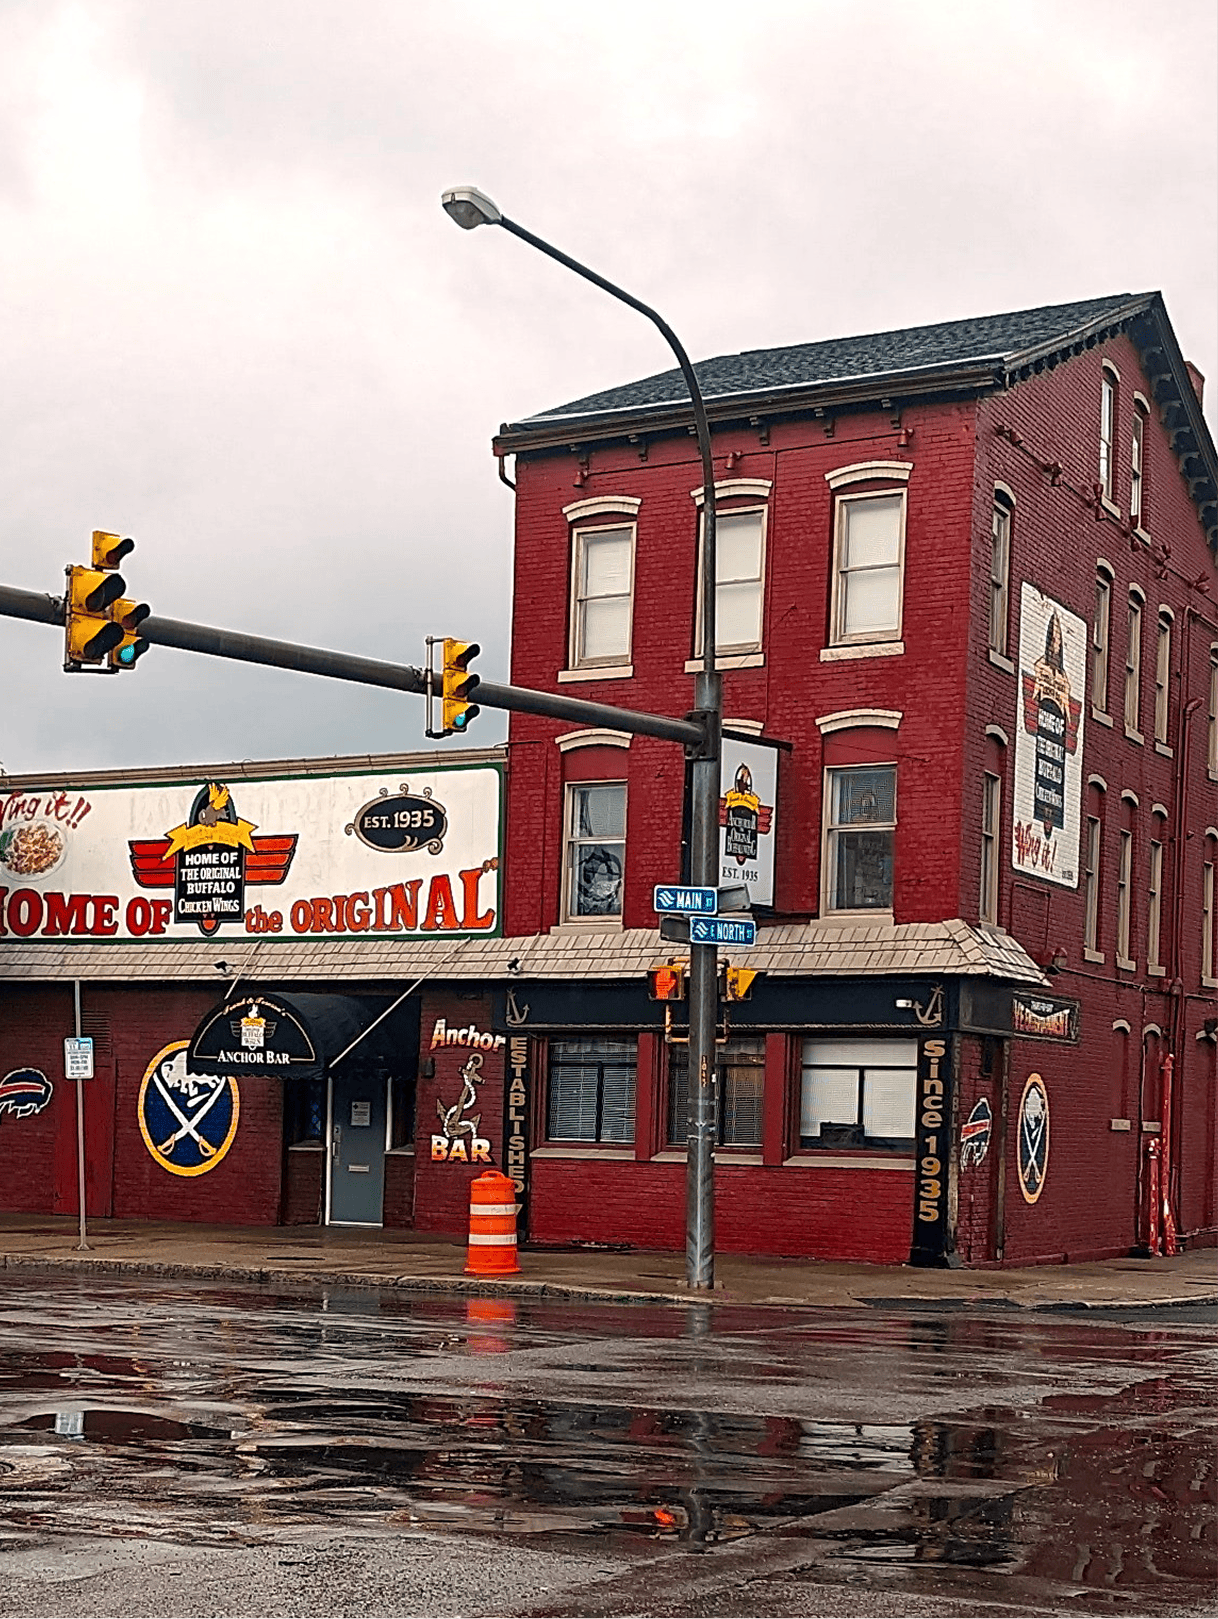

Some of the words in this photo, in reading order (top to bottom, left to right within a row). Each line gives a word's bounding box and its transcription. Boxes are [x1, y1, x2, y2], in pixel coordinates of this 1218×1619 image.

[44, 790, 92, 829] it!!
[364, 815, 391, 829] EST.
[394, 809, 436, 828] 1935
[185, 852, 220, 867] HOME
[221, 851, 239, 864] OF
[180, 868, 200, 881] THE
[200, 866, 242, 881] ORIGINAL
[722, 866, 739, 880] EST.
[741, 869, 758, 882] 1935
[186, 881, 236, 895] BUFFALO
[125, 896, 173, 937] OF
[244, 904, 283, 933] the
[290, 867, 497, 933] ORIGINAL
[676, 891, 702, 909] MAIN
[716, 922, 745, 941] NORTH
[430, 1018, 506, 1052] Anchor
[217, 1049, 264, 1064] ANCHOR
[266, 1050, 290, 1064] BAR
[921, 1039, 946, 1129] Since
[431, 1134, 492, 1163] BAR
[918, 1135, 942, 1222] 1935
